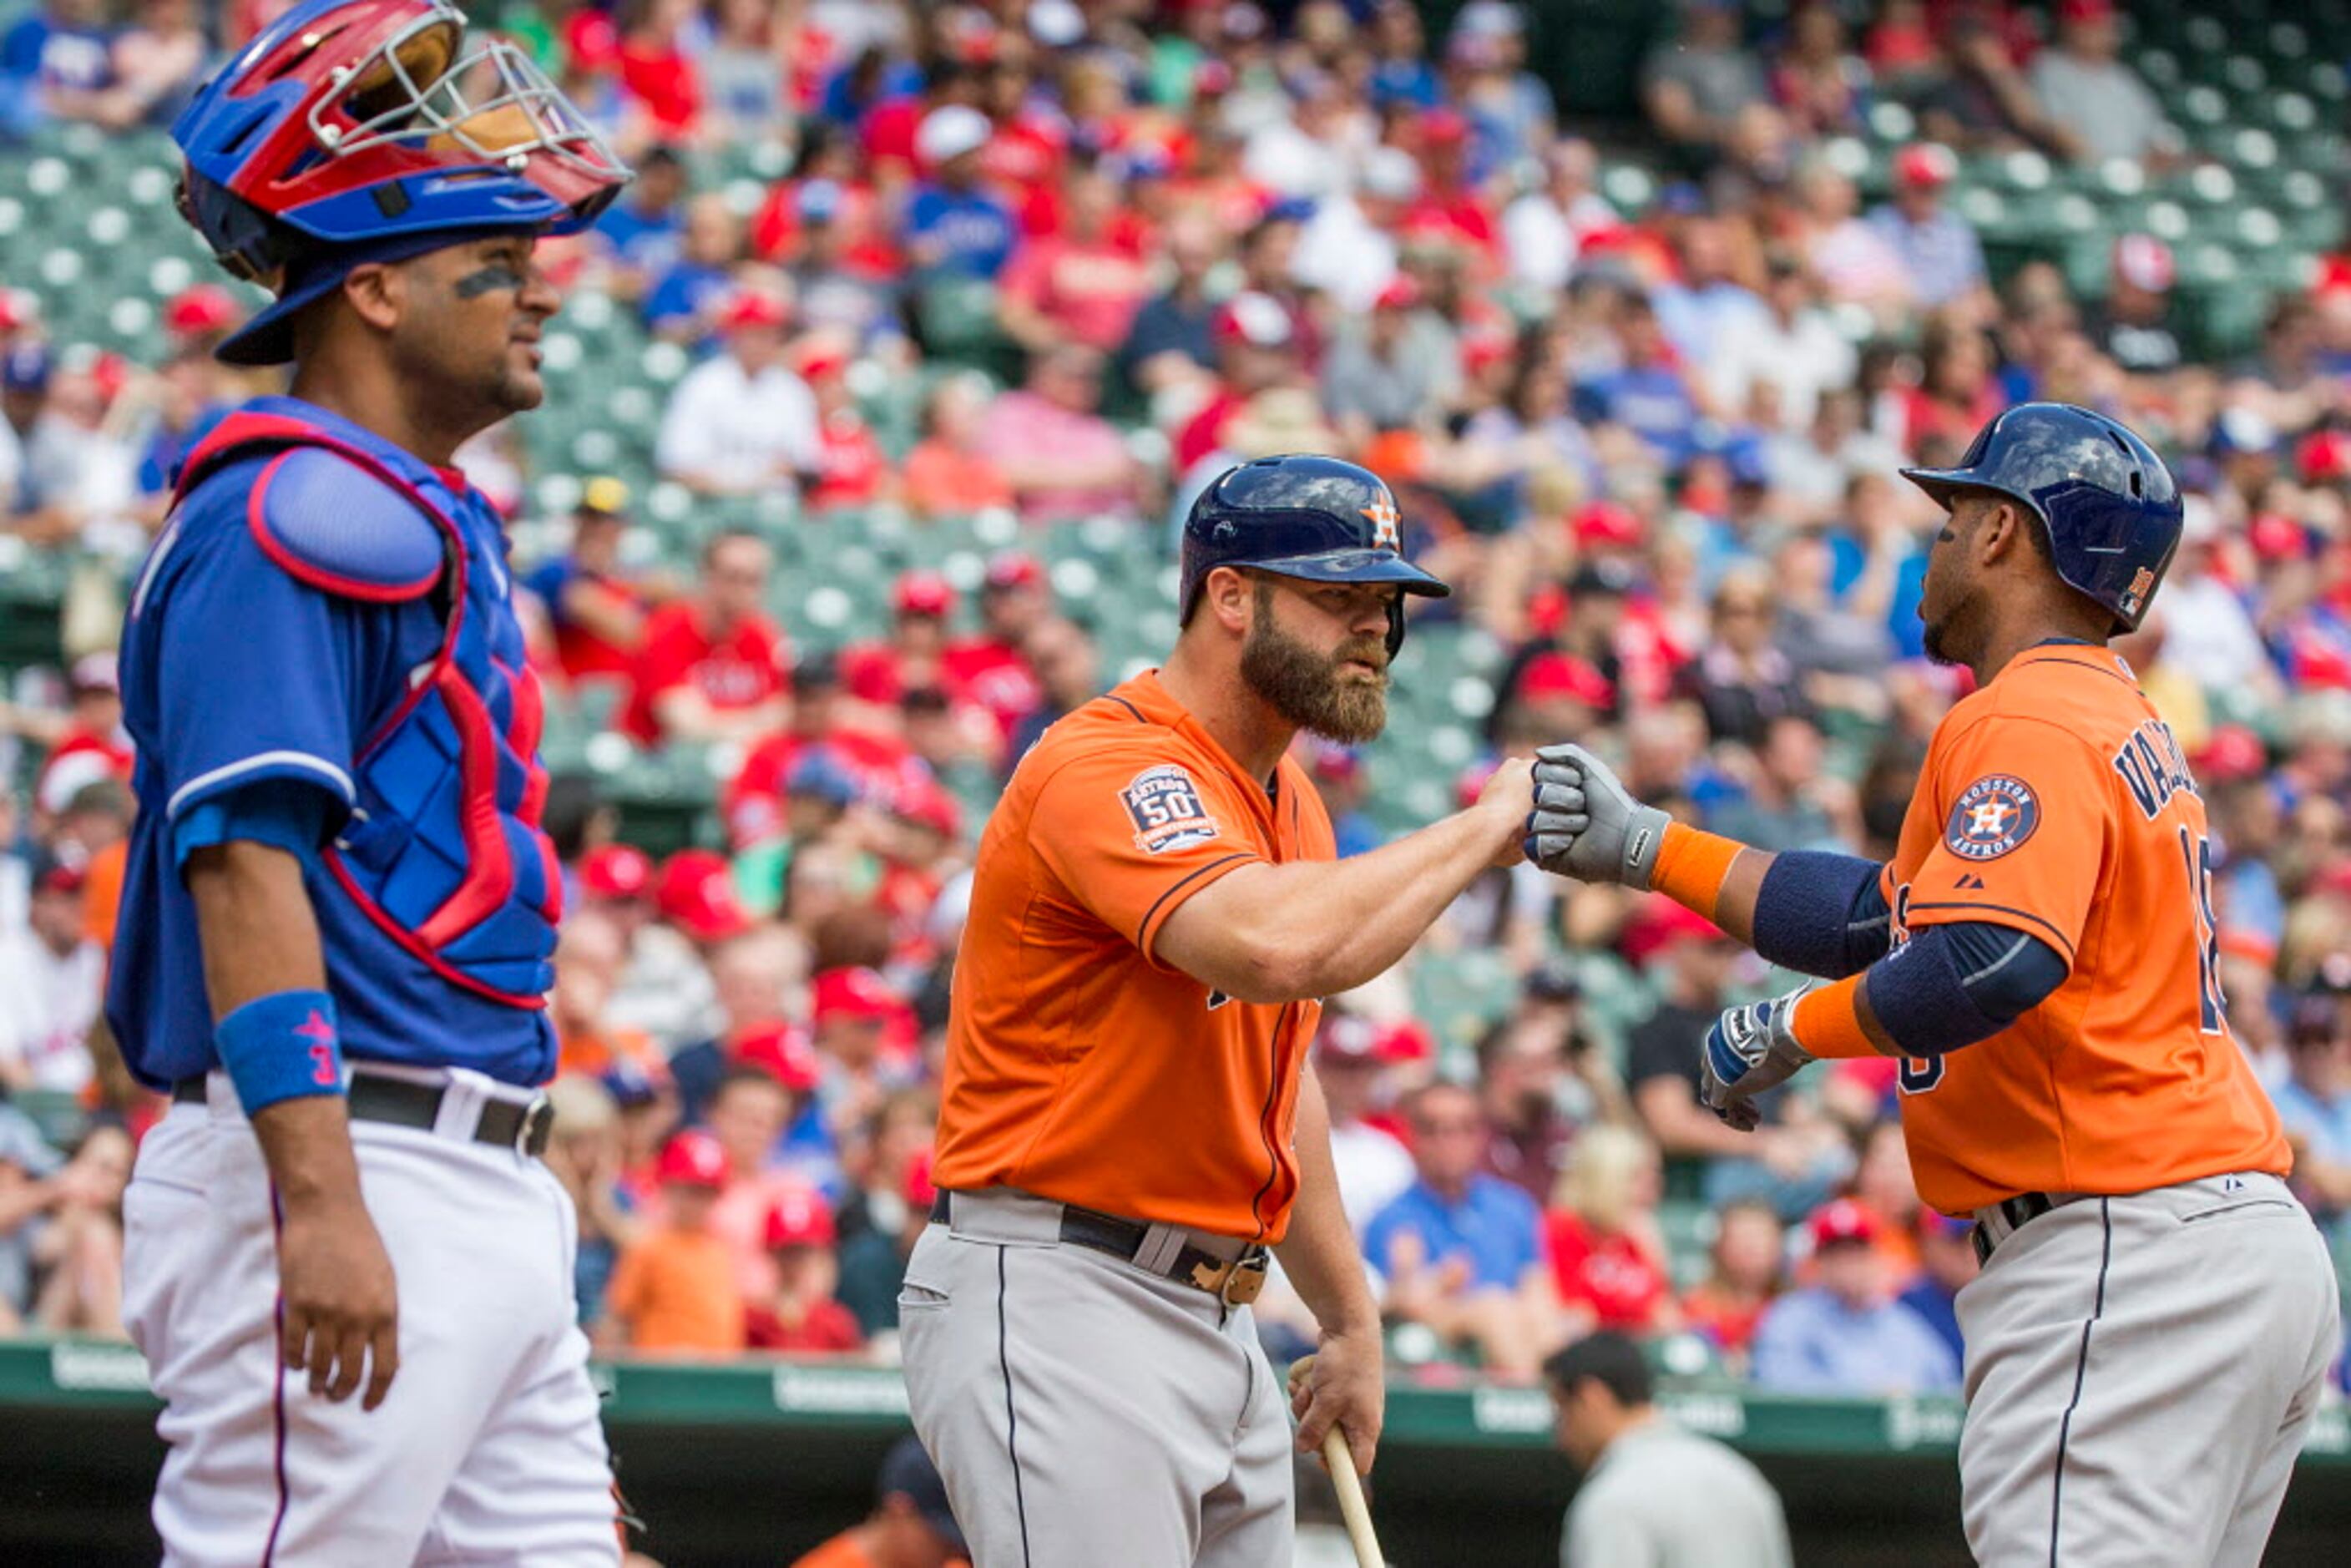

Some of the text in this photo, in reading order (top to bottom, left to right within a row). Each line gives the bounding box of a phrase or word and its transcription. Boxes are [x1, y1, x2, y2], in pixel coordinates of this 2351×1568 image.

[1370, 503, 1399, 544] H
[1959, 778, 2031, 807] HOUSTON
[1140, 791, 1196, 827] 50
[1969, 802, 2009, 834] H
[1951, 835, 2015, 857] ASTROS
